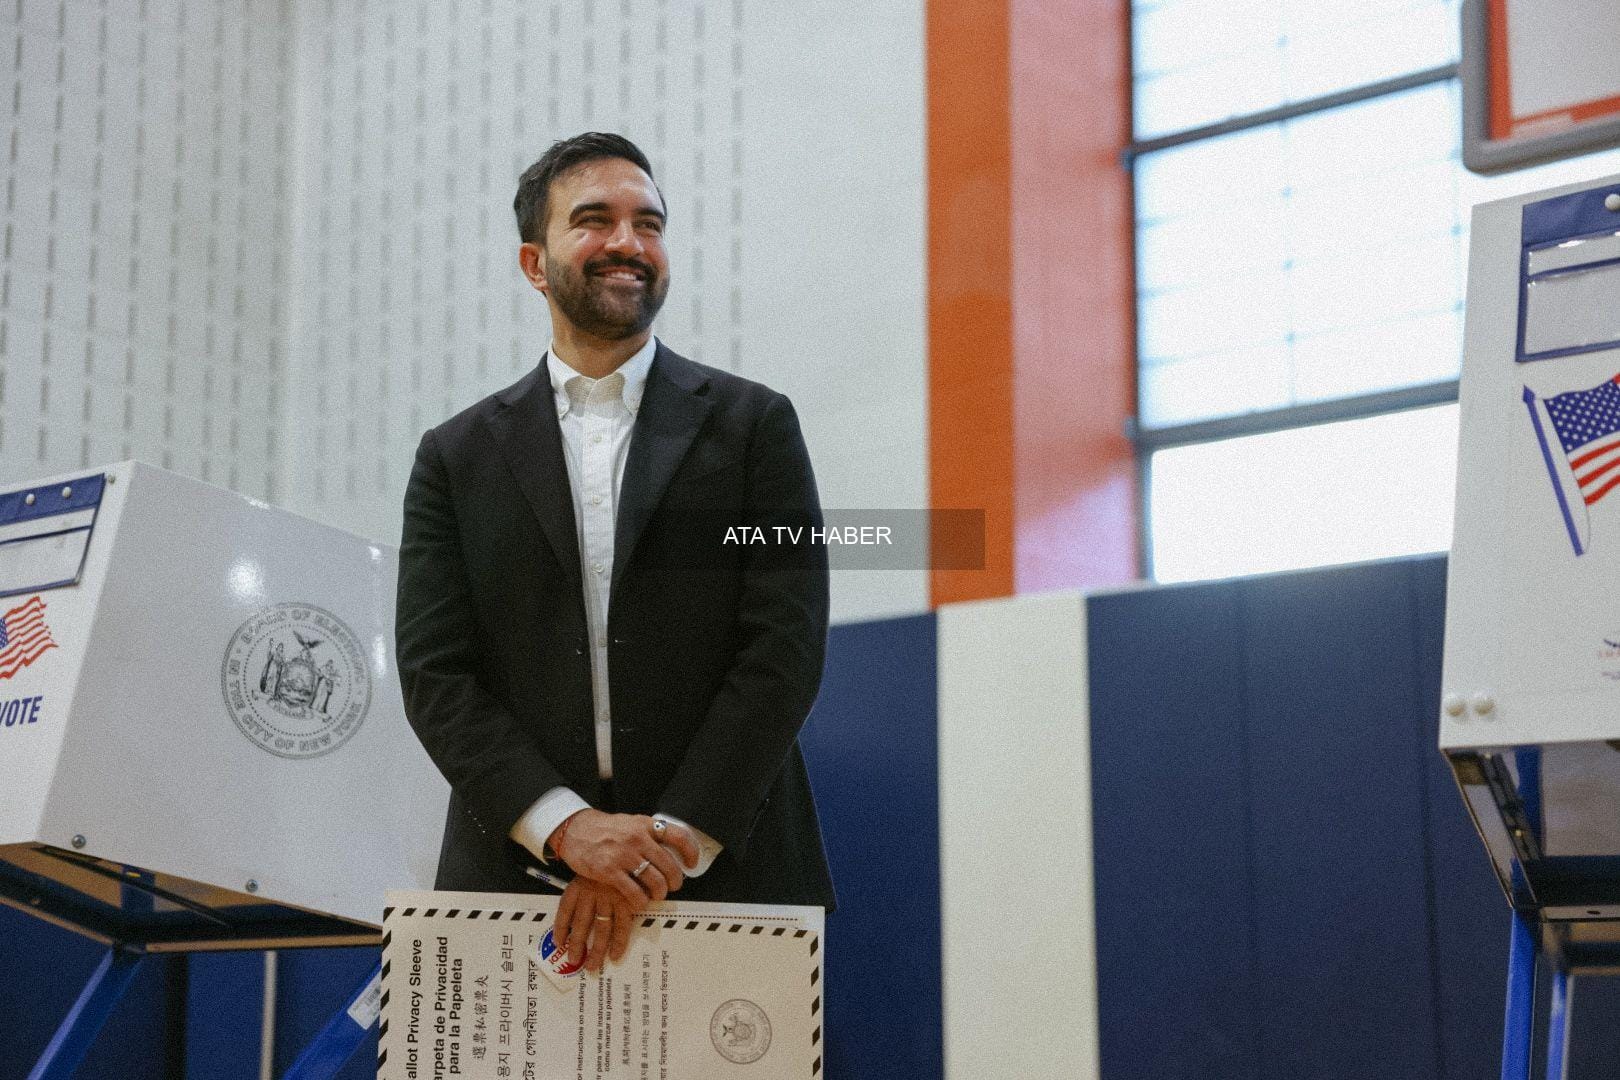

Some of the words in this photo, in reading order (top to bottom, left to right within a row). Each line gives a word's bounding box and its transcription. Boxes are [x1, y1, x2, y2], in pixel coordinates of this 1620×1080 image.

[409, 939, 422, 986] Sleeve
[500, 933, 514, 973] 슬리브
[435, 936, 448, 1011] Privacidad
[449, 958, 464, 1020] Papeleta
[498, 979, 514, 1046] 프라이버시
[578, 983, 586, 1013] marking
[606, 1011, 611, 1021] su
[407, 991, 423, 1043] Privacy
[433, 1015, 446, 1034] de
[449, 1025, 460, 1037] la
[578, 1015, 584, 1025] on
[406, 1047, 419, 1080] allot
[433, 1038, 446, 1080] arpeta
[449, 1042, 461, 1074] para
[497, 1052, 511, 1080] 용지
[576, 1026, 584, 1071] instructions
